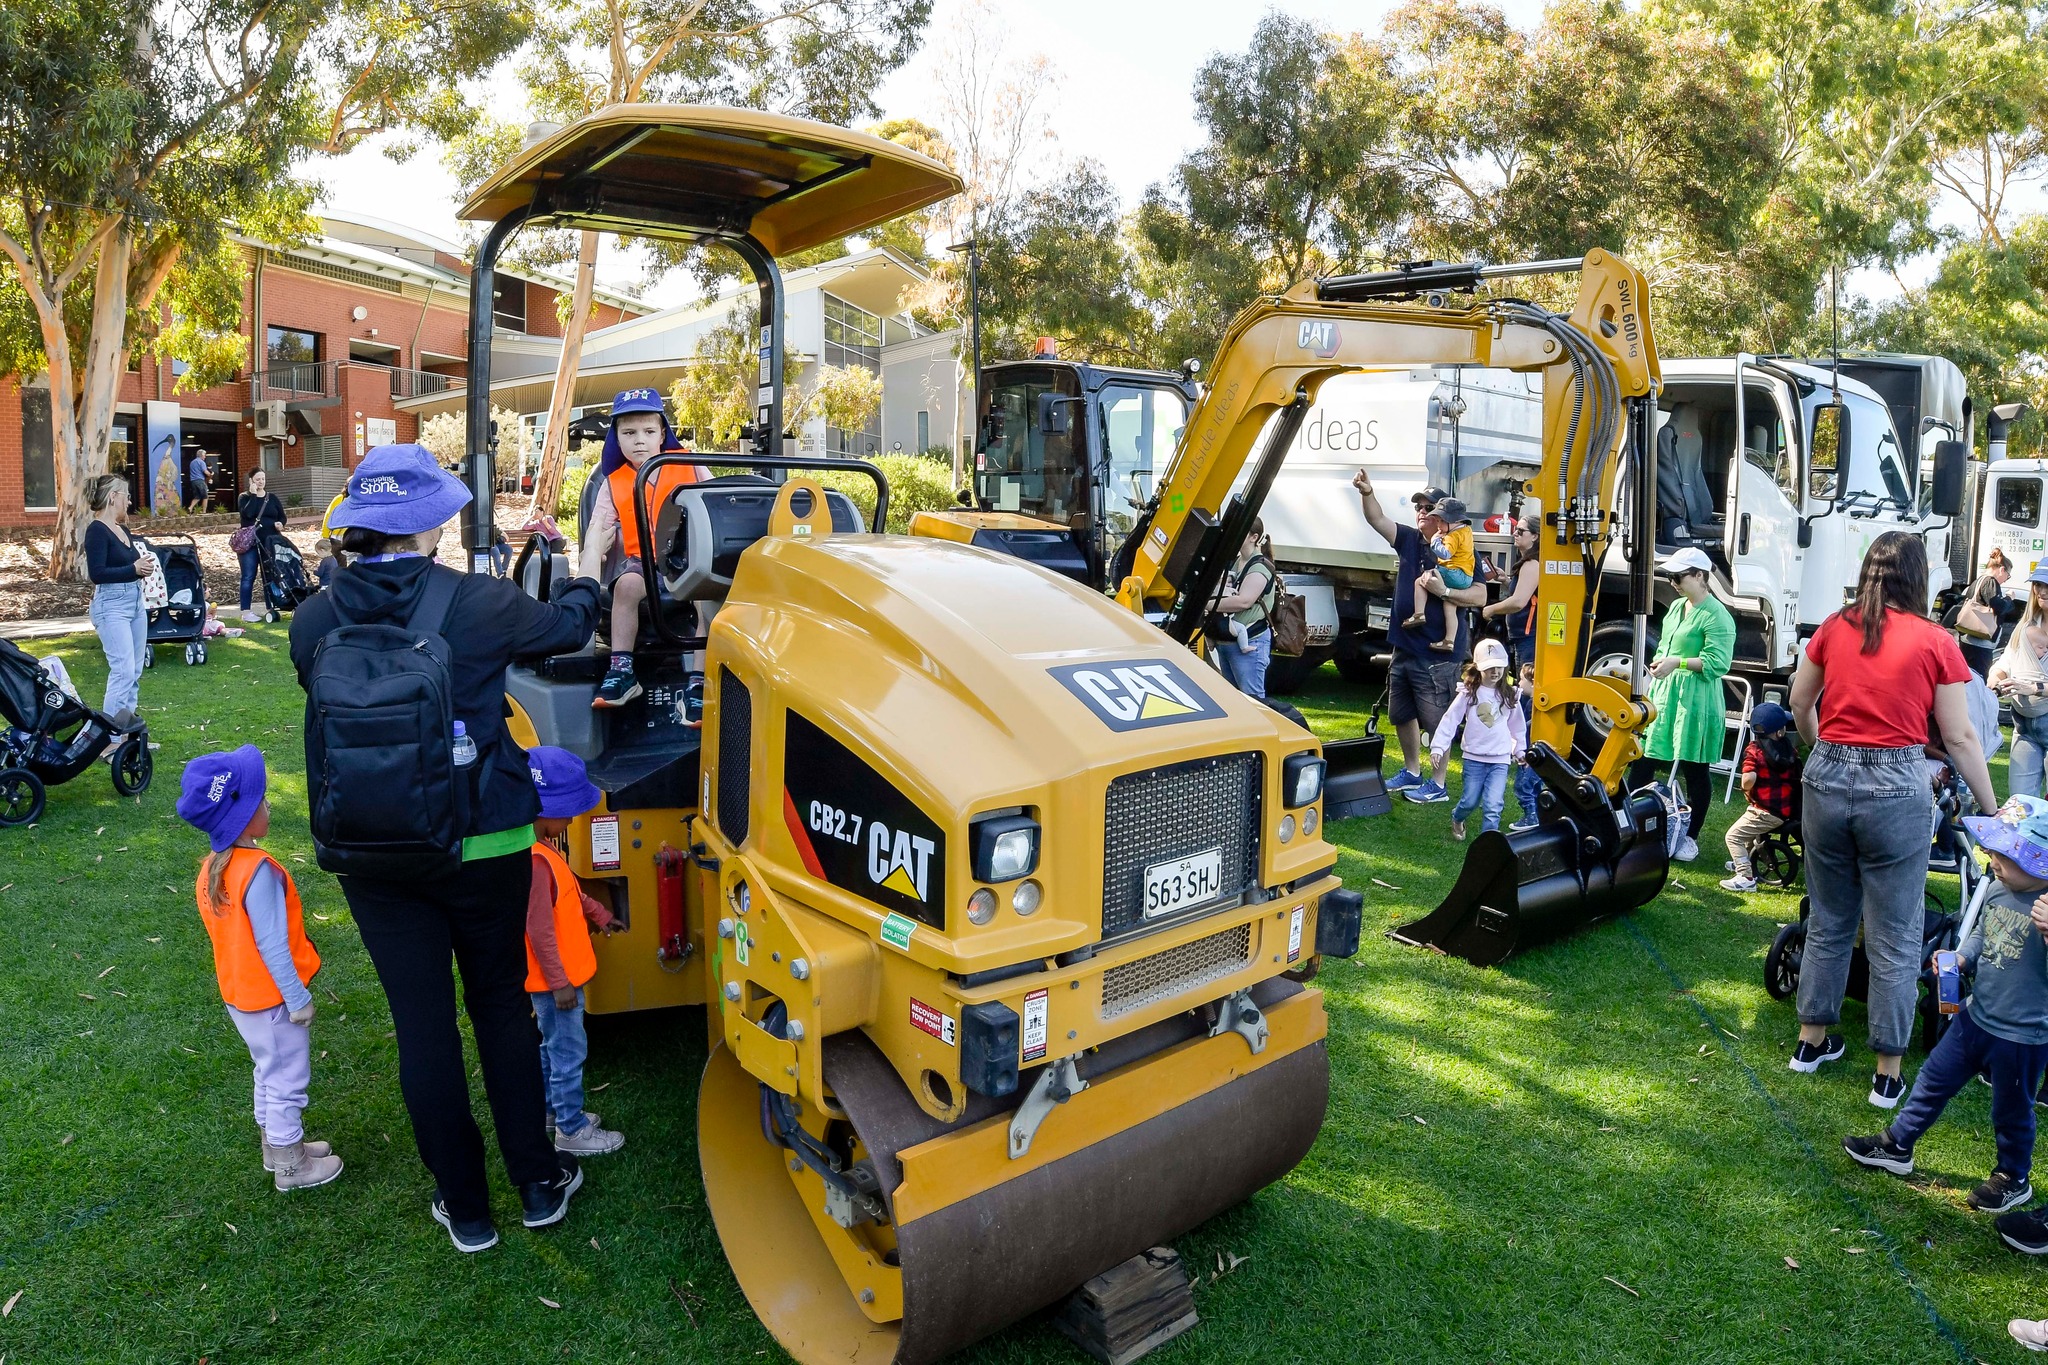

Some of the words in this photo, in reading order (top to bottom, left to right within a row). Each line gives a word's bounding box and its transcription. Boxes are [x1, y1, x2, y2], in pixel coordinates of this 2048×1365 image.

[1617, 279, 1632, 313] SWL
[1622, 313, 1638, 341] 600
[1298, 321, 1333, 350] CAT
[1628, 342, 1638, 358] kg
[1183, 426, 1217, 490] outside
[1213, 380, 1240, 427] ideas
[360, 481, 399, 494] Stone
[2011, 511, 2030, 519] 2837
[2009, 538, 2030, 546] 12.940
[1072, 664, 1205, 721] CAT
[211, 775, 226, 802] Stone
[810, 800, 863, 846] CB2.7
[868, 821, 935, 902] CAT
[1180, 861, 1192, 872] SA
[885, 918, 912, 933] BATTERY
[882, 927, 908, 943] ISOLATOR
[1029, 989, 1047, 1000] DANGER
[1026, 998, 1046, 1008] CRUSH
[1028, 1004, 1043, 1014] ZONE
[911, 1002, 941, 1023] RECOVERY
[911, 1010, 925, 1024] TOW
[924, 1016, 942, 1032] POINT
[1025, 1036, 1043, 1046] CLEAR
[1027, 1031, 1042, 1040] KEEP
